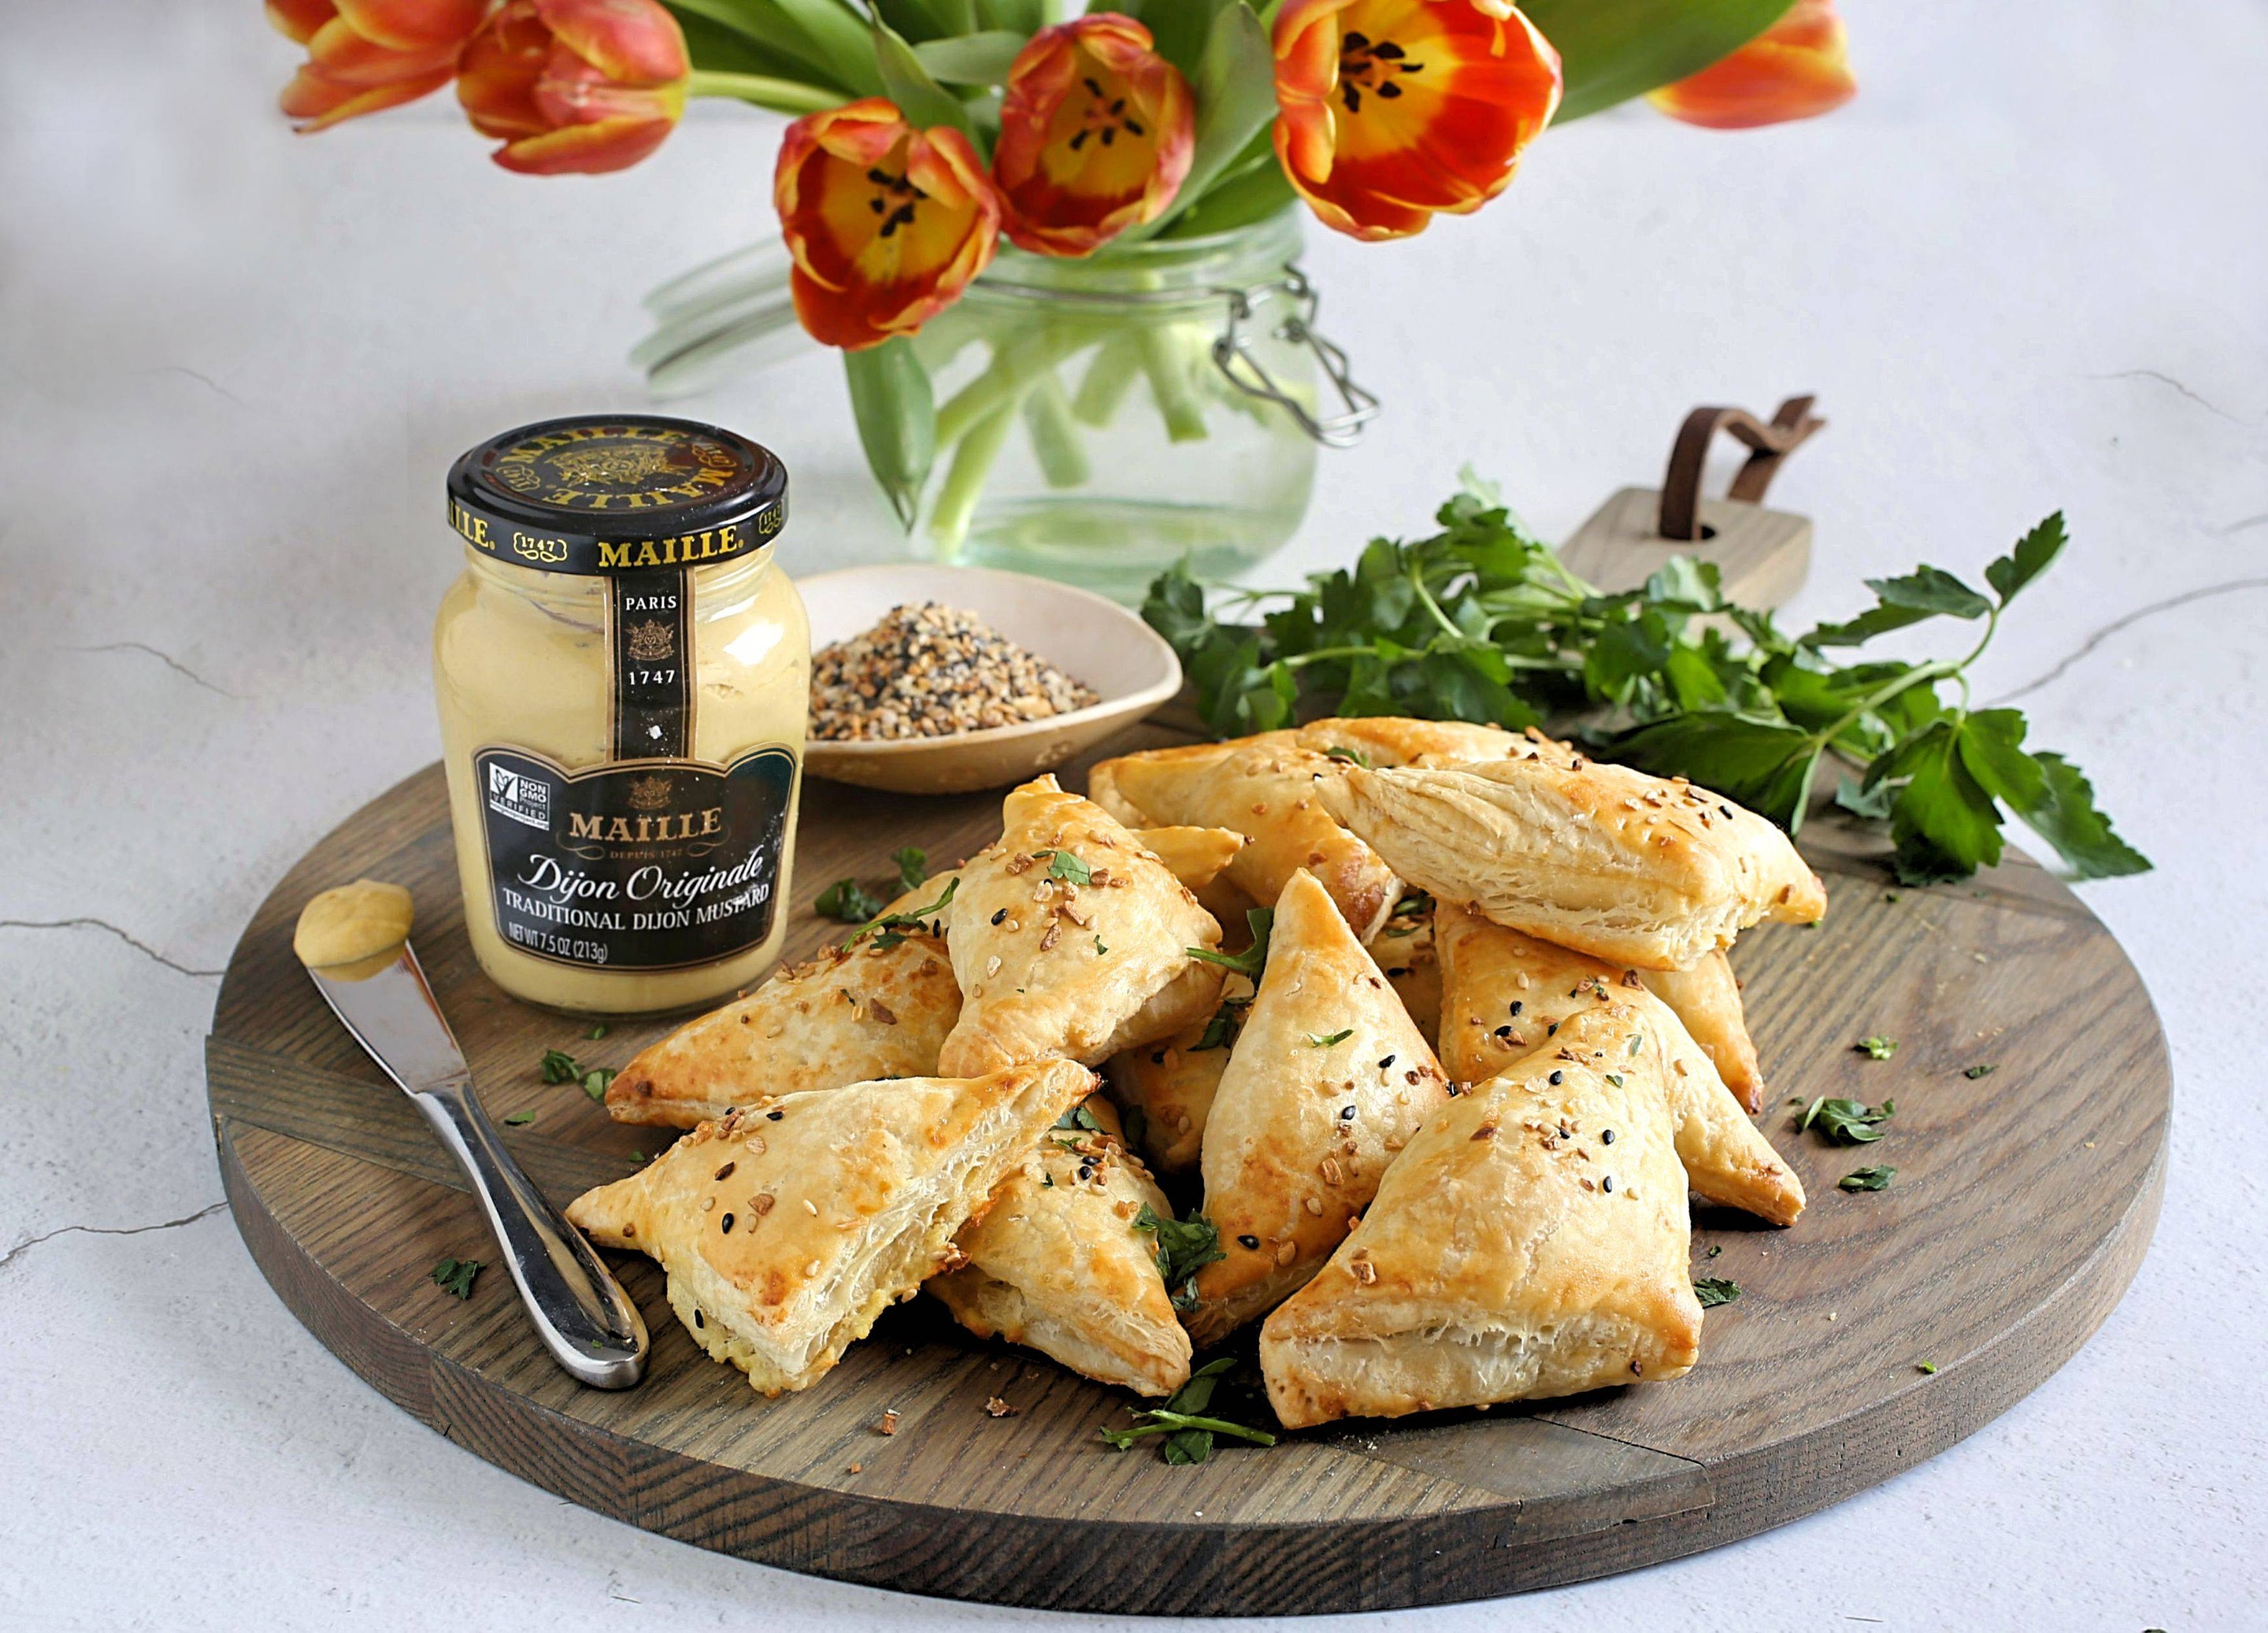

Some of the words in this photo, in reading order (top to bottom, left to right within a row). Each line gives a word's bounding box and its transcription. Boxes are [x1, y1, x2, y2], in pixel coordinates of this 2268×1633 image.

[500, 427, 689, 465] MAILLE
[542, 467, 736, 509] MAILLE
[521, 536, 554, 552] 1747
[598, 525, 737, 568] MAILLE
[625, 595, 677, 611] PARIS
[629, 669, 675, 685] 1747
[520, 779, 547, 795] NON
[520, 788, 547, 803] GMO
[493, 794, 546, 820] VERIFIED
[569, 806, 722, 842] MAILLE
[610, 850, 655, 860] DEPUIS
[661, 849, 683, 858] 1747
[517, 854, 621, 905] Dijon
[626, 844, 765, 910] Originale
[502, 887, 626, 931] TRADITIONAL
[632, 909, 691, 931] DIJON
[696, 883, 770, 925] MUSTARD
[508, 920, 524, 942] NET
[524, 927, 539, 947] WT
[540, 929, 556, 953] 7.5
[557, 936, 572, 956] OZ
[573, 940, 608, 965] (213g)
